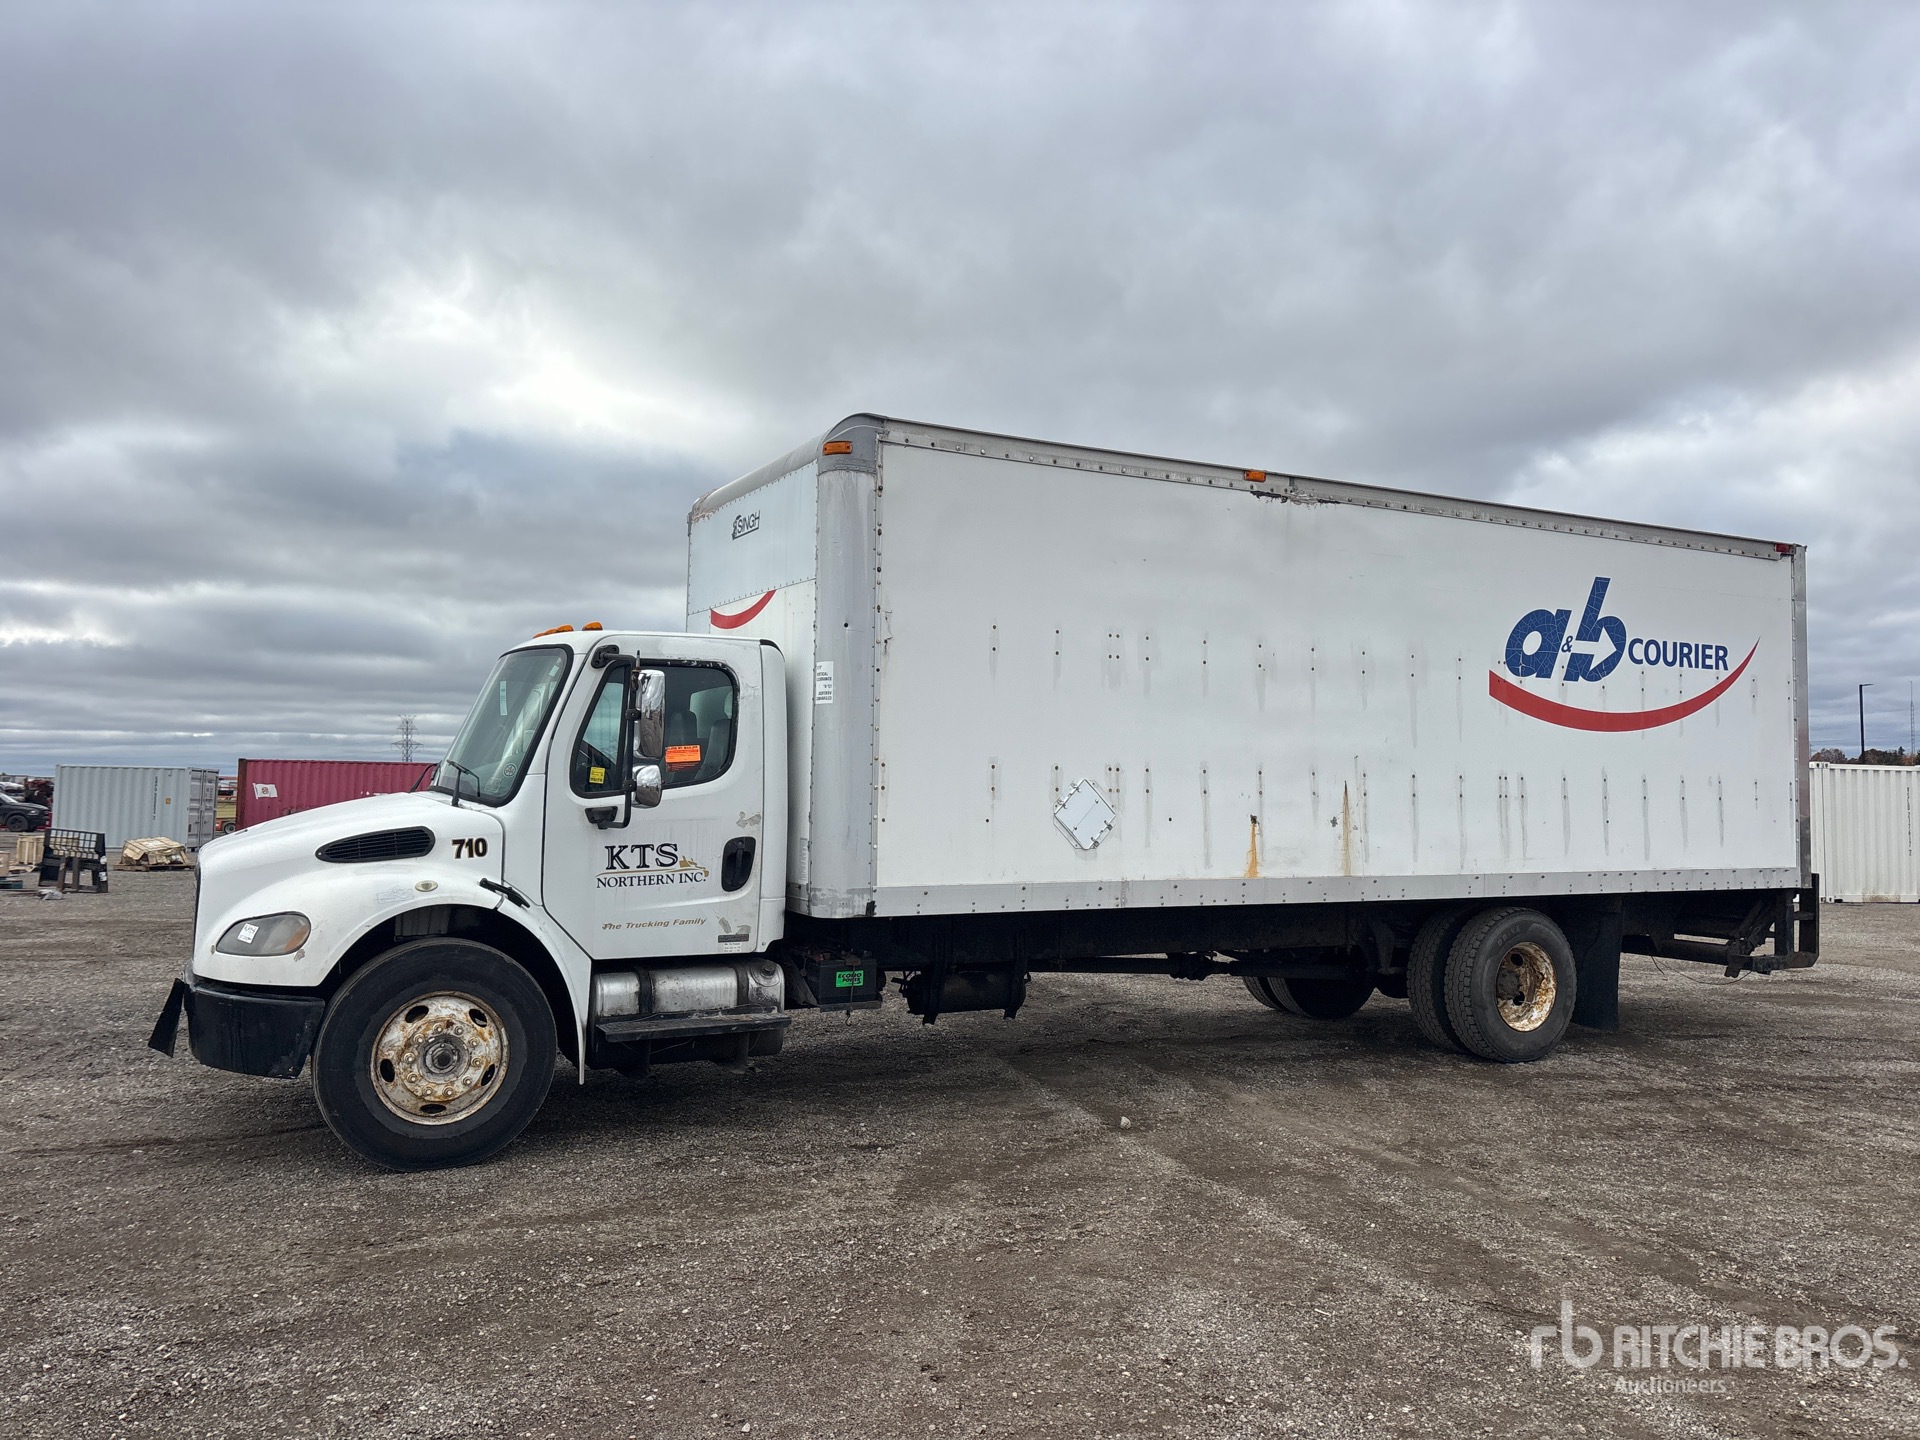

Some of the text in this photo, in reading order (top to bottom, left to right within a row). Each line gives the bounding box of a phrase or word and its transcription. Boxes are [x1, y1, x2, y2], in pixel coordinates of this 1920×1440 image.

[1628, 638, 1729, 671] COURIER
[451, 837, 488, 860] 710
[605, 843, 678, 870] KTS
[597, 872, 706, 888] NORTHERN INC.
[602, 917, 708, 930] The Trucking Family
